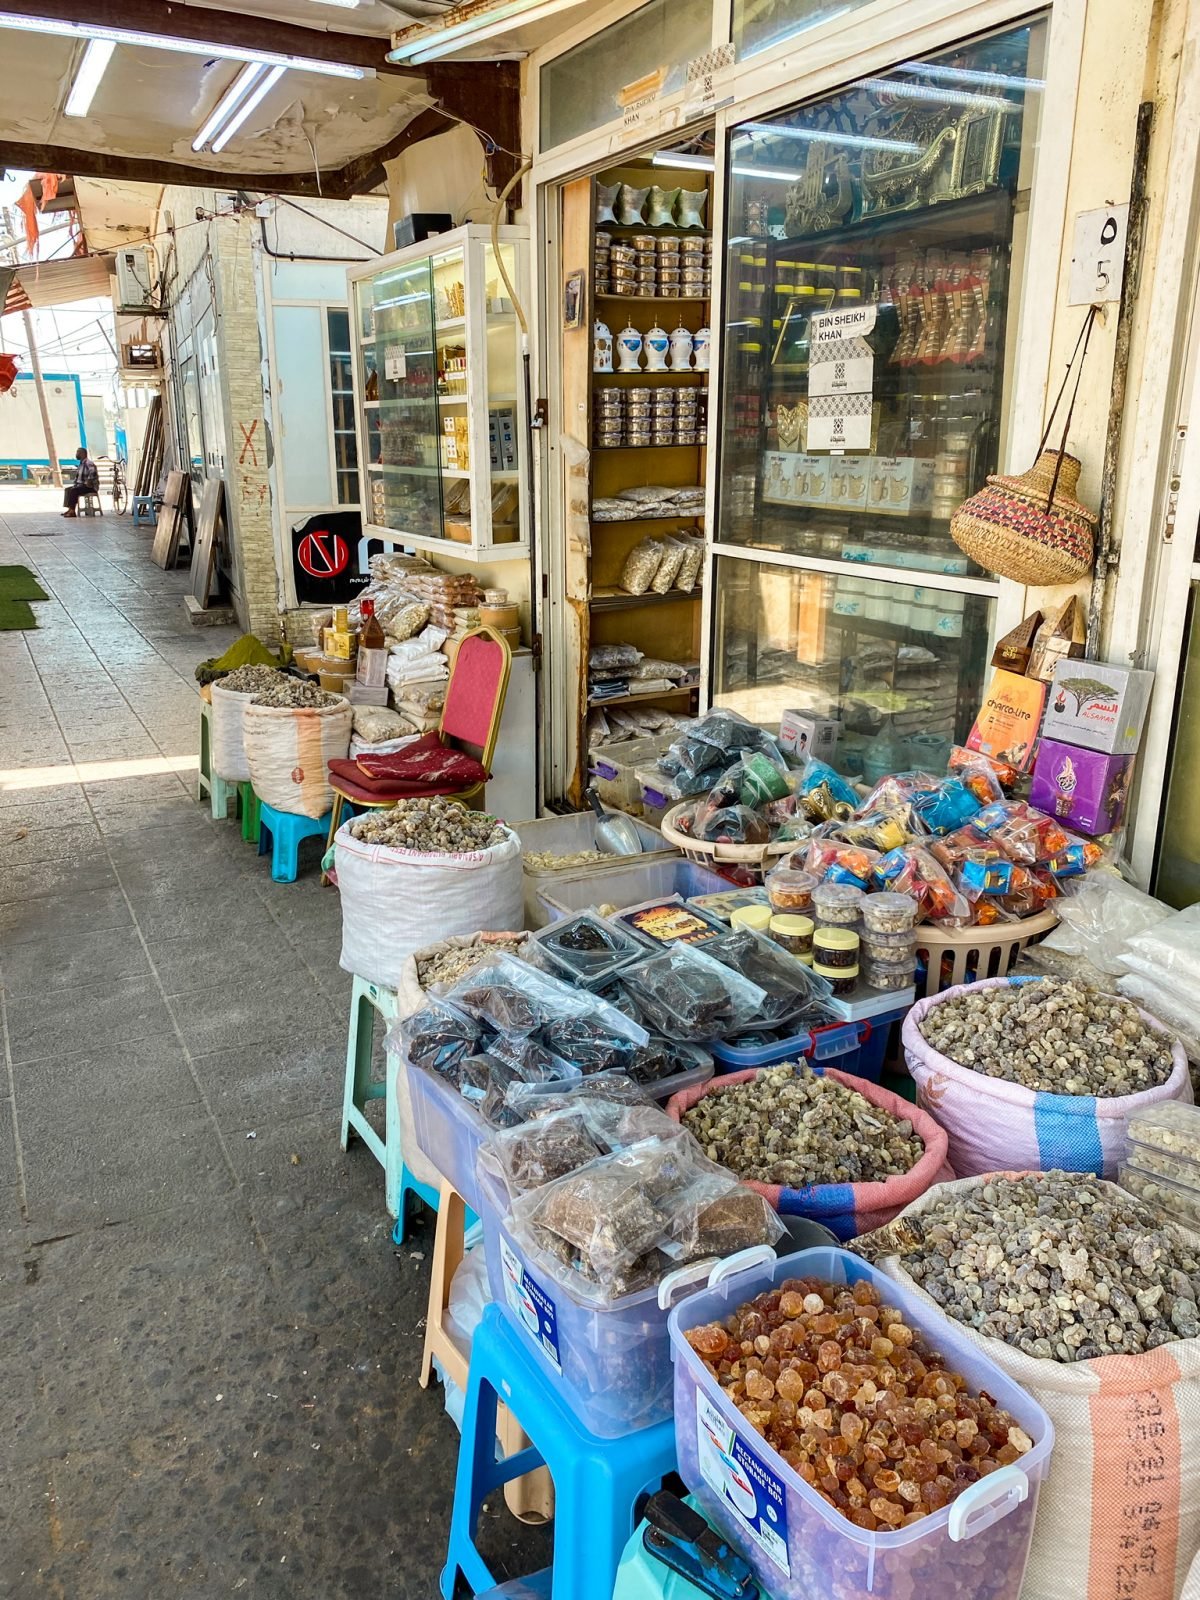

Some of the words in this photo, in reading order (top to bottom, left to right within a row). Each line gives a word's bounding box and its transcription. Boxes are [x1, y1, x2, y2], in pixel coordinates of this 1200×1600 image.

[1095, 260, 1112, 292] 5
[818, 316, 834, 328] BIN
[834, 311, 866, 326] SHEIKH
[818, 329, 842, 341] KHAN
[1081, 711, 1116, 724] ALSAMAR
[735, 1441, 783, 1496] RECTANGULAR
[737, 1453, 767, 1490] STORAGE
[767, 1485, 783, 1507] BOX
